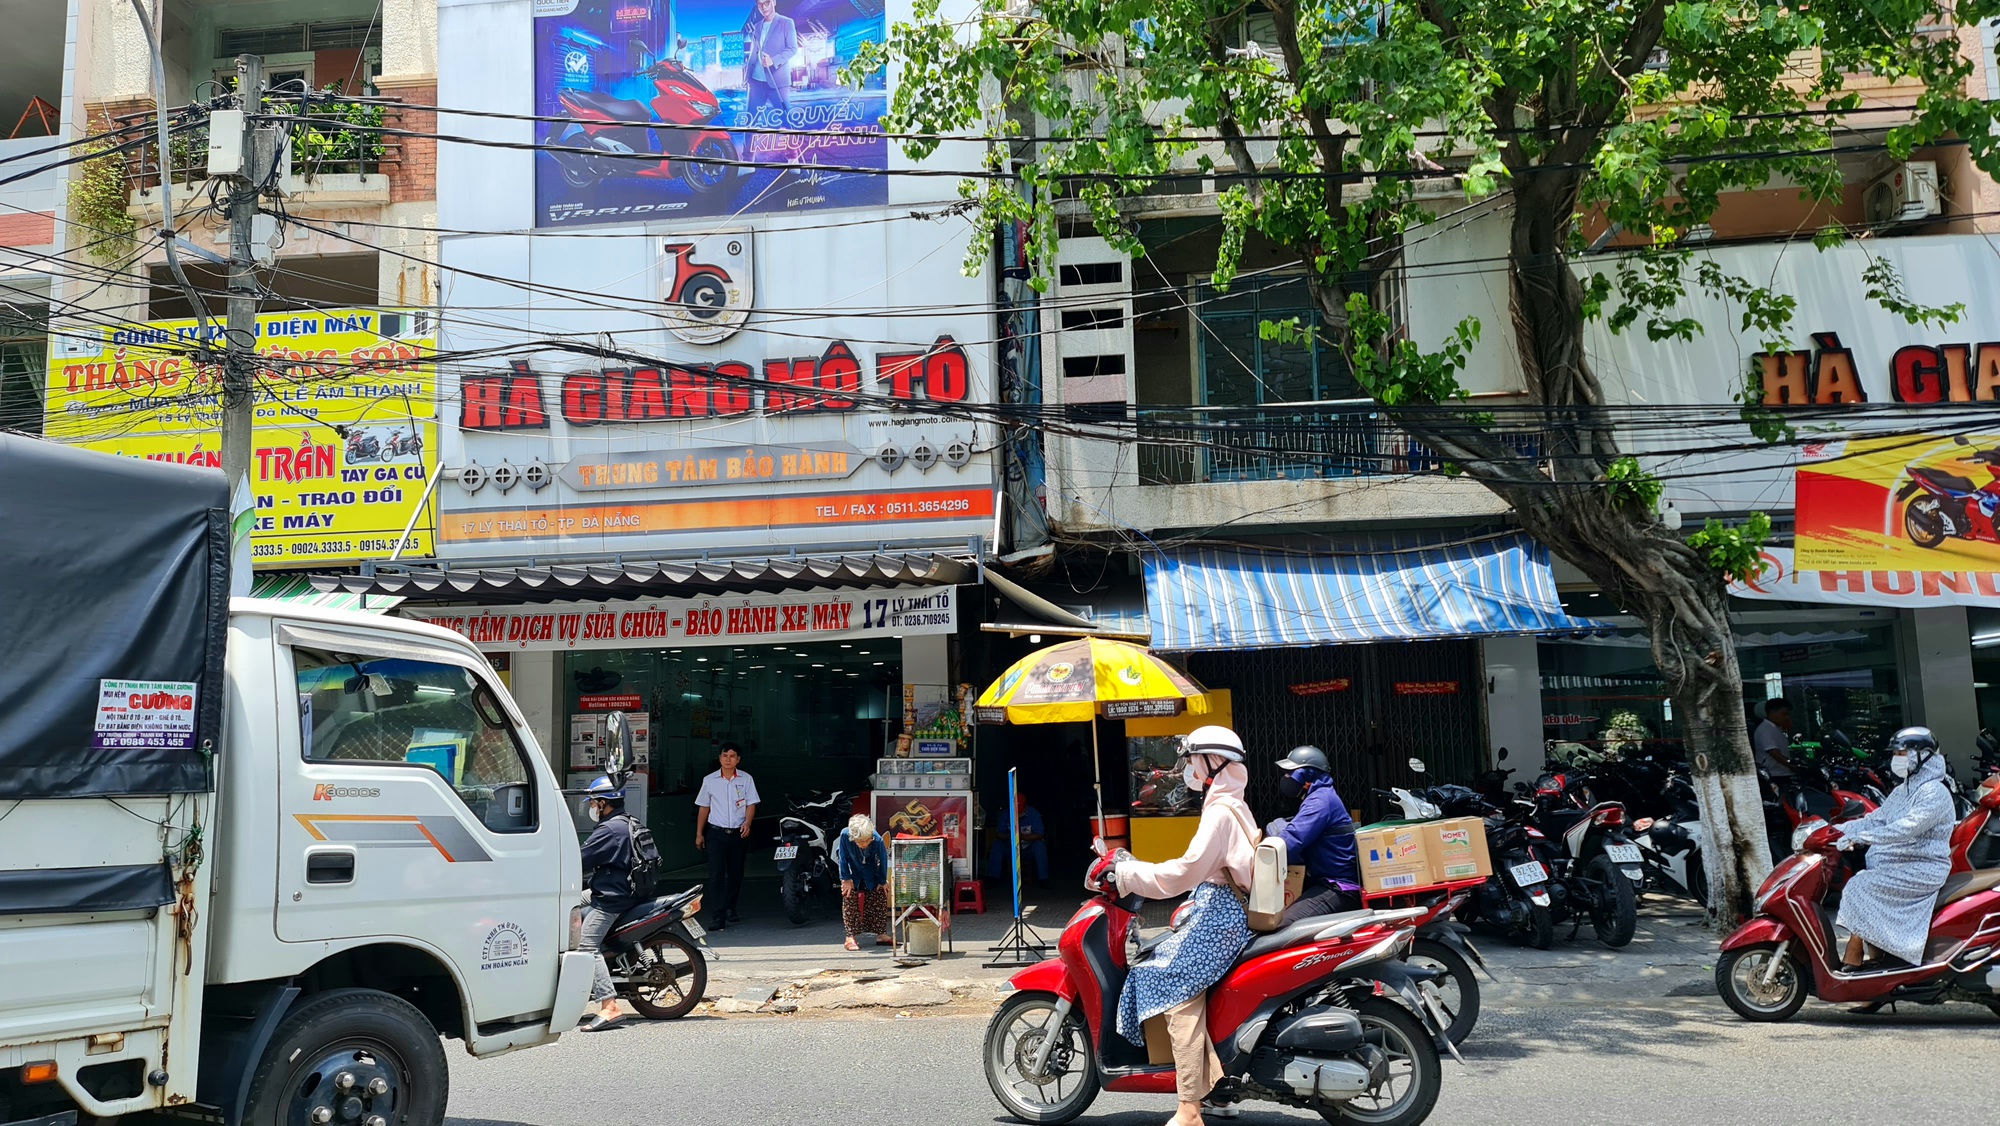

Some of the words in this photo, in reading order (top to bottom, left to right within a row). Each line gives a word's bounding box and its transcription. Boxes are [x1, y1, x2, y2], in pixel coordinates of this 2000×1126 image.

[615, 8, 647, 17] HEAD
[267, 317, 317, 338] ĐIỆN
[325, 315, 372, 332] MÁY
[63, 347, 181, 393] THẮNG
[350, 342, 422, 375] SƠN
[1752, 332, 1868, 405] HÀ
[315, 384, 344, 400] ÂM
[351, 382, 421, 398] THANH
[459, 358, 550, 432] HÀ
[561, 359, 754, 427] GIANG
[762, 340, 863, 416] MÔ
[876, 334, 970, 405] TÔ
[256, 406, 276, 417] Đà
[255, 431, 336, 484] TRẦN
[341, 469, 369, 482] TAY
[374, 468, 398, 481] GA
[579, 462, 659, 487] TRUNG
[665, 454, 718, 482] TÂM
[726, 448, 774, 479] BẢO
[781, 447, 848, 476] HÀNH
[298, 491, 355, 506] TRAO
[363, 485, 402, 502] ĐỔI
[816, 505, 840, 518] TEL
[851, 503, 876, 516] FAX
[887, 498, 969, 515] 0511.3654296
[283, 512, 334, 529] MÁY
[462, 522, 475, 534] 17
[479, 518, 493, 533] LÝ
[498, 517, 526, 532] THÁI
[558, 518, 574, 530] TP
[582, 514, 599, 529] ĐÀ
[604, 511, 641, 527] NẴNG
[292, 541, 351, 555] 09024.3333.5
[892, 595, 905, 612] LÝ
[908, 594, 933, 610] THÁI
[468, 610, 505, 643] TÂM
[509, 614, 555, 648] DỊCH
[558, 612, 582, 647] VỤ
[582, 605, 617, 640] SỬA
[620, 605, 668, 639] CHỮA
[684, 600, 724, 637] BẢO
[726, 600, 778, 636] HÀNH
[780, 603, 810, 635] XE
[811, 595, 853, 632] MÁY
[863, 598, 888, 629] 17
[892, 614, 902, 628] ĐT:
[905, 613, 950, 627] 0236.7109245
[129, 690, 193, 711] CƯỜNG
[103, 738, 117, 746] ĐT:
[120, 738, 144, 746] 0988
[148, 738, 165, 746] 453
[167, 738, 184, 746] 455
[1442, 831, 1467, 840] HOMEY
[1515, 864, 1537, 875] 92-E1
[484, 927, 498, 945] TNHH
[1322, 947, 1354, 962] mode
[480, 963, 492, 971] KIM
